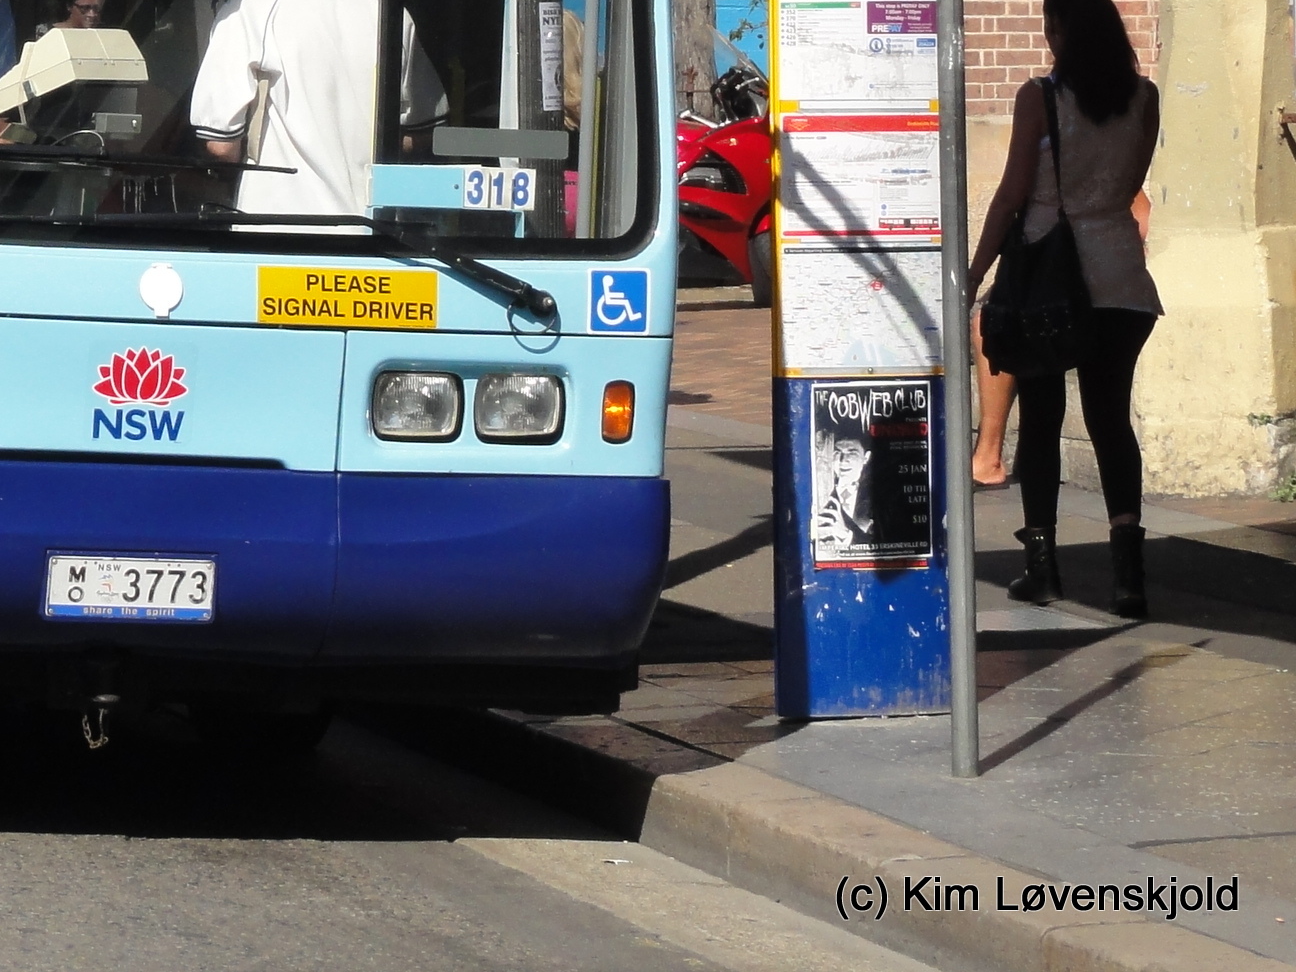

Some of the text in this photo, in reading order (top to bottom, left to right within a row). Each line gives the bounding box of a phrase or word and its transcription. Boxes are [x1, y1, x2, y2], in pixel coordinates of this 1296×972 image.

[467, 170, 530, 210] 318
[305, 273, 392, 295] PLEASE
[262, 297, 435, 322] SIGNAL DRIVER
[815, 390, 829, 406] THE
[828, 388, 894, 434] COBWEB
[894, 388, 926, 412] CLUB
[92, 407, 185, 442] NSW
[911, 465, 927, 474] JAN
[908, 495, 927, 503] LATE
[97, 563, 122, 572] NSW
[121, 568, 209, 605] 3773
[83, 607, 176, 617] share the spirit
